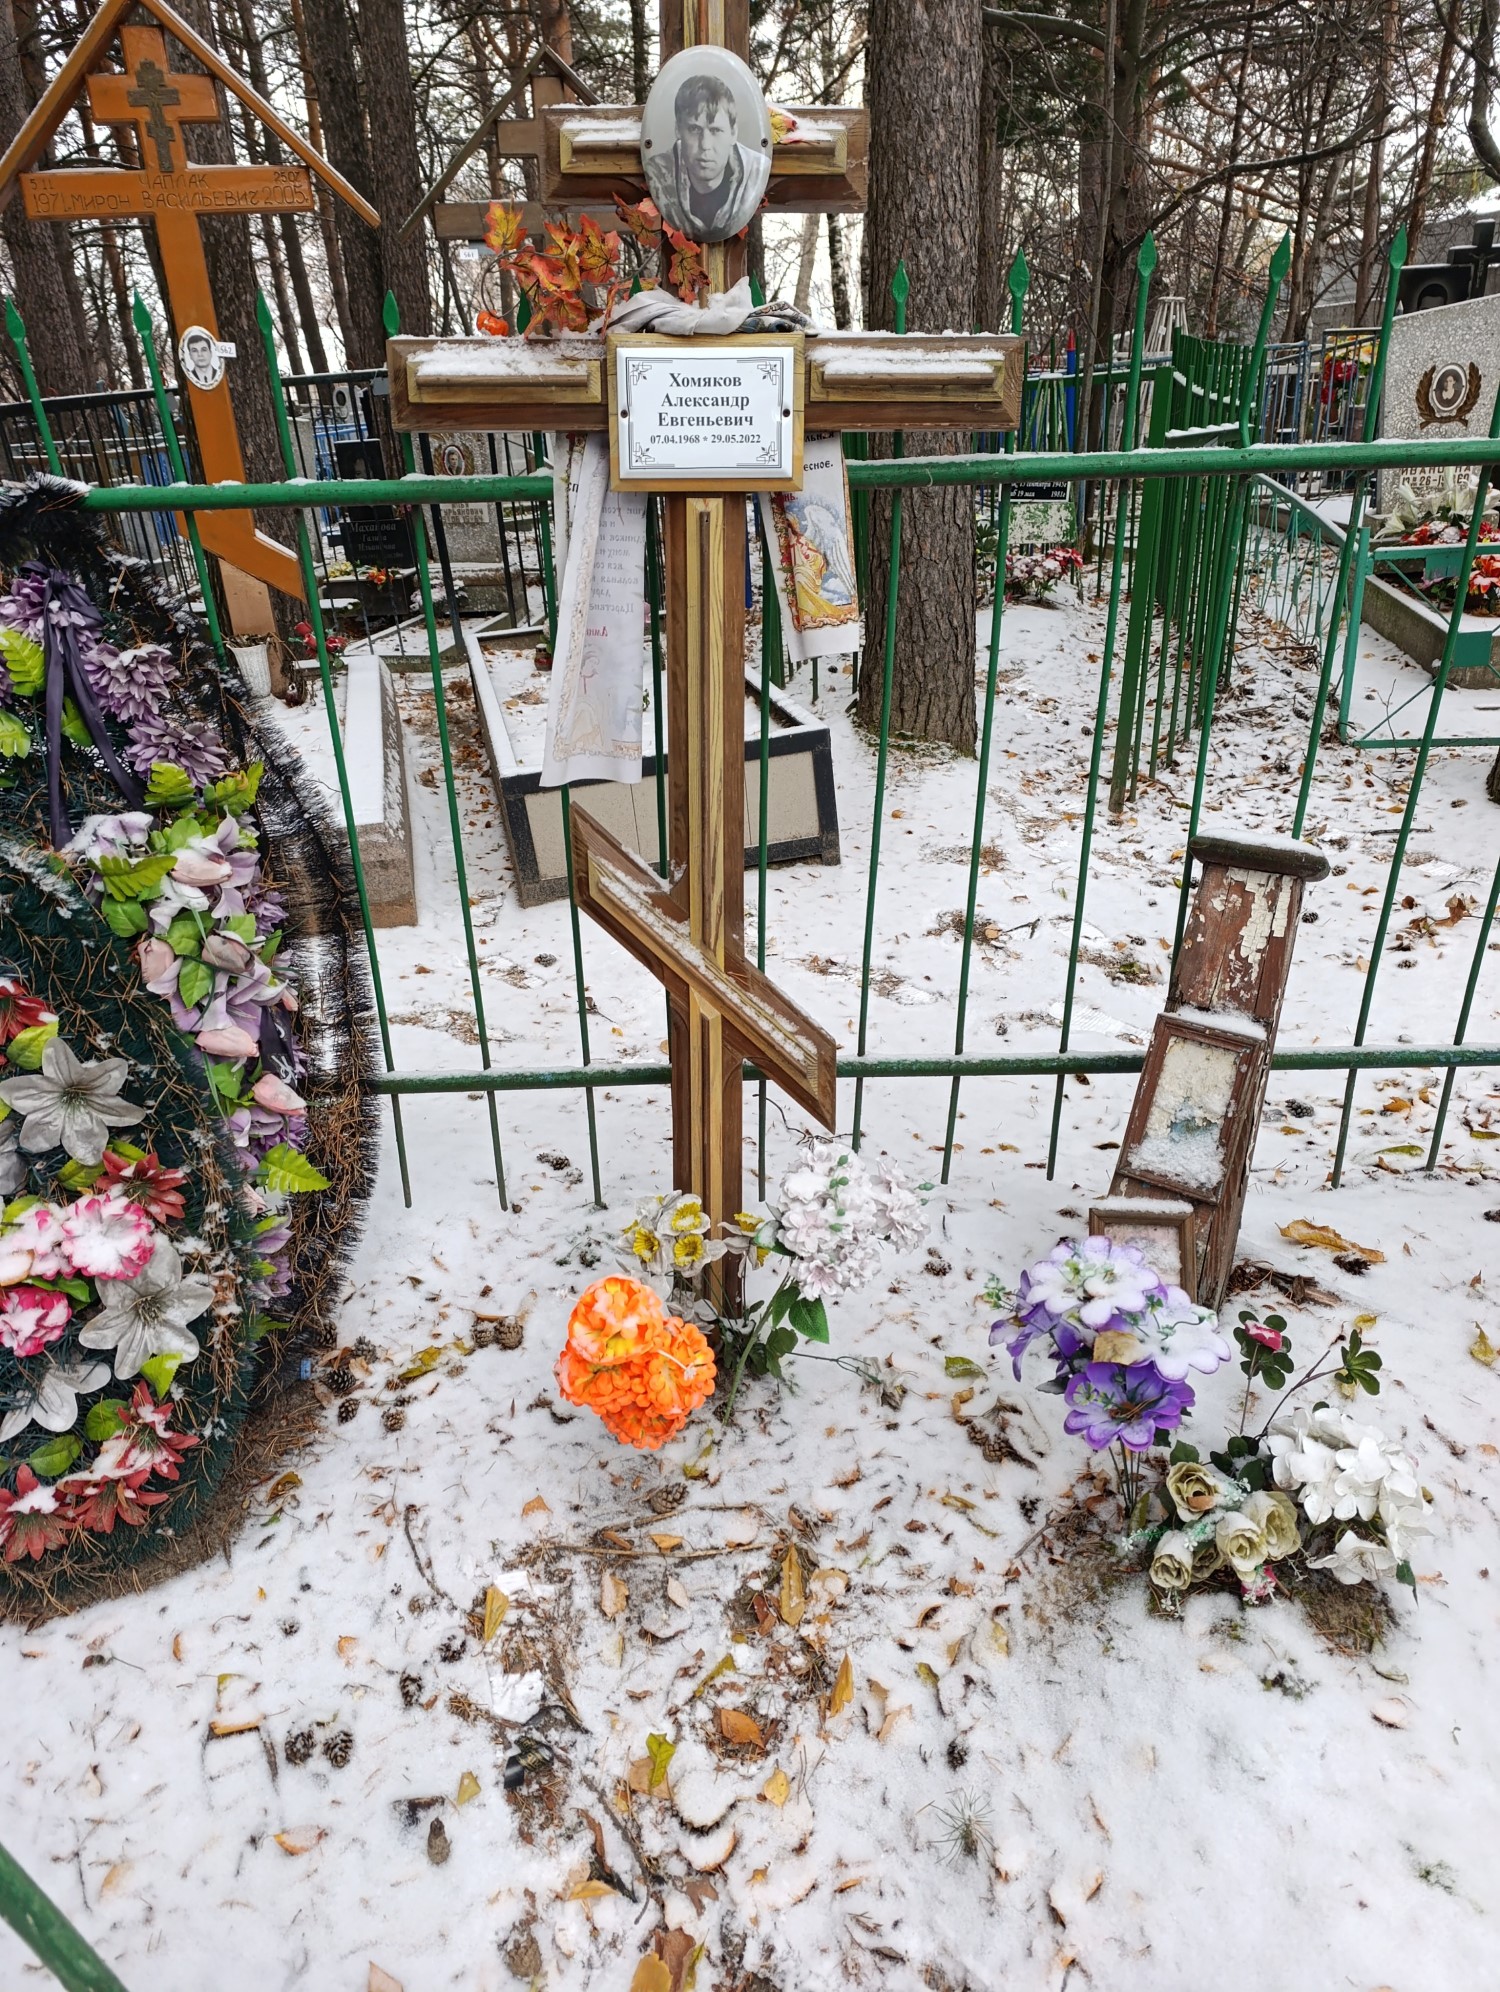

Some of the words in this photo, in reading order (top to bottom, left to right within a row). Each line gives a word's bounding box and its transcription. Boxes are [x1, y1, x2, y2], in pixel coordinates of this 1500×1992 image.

[138, 173, 209, 190] ЧАПЛАК
[141, 190, 259, 209] ВАСИЛЬЕВИЧ
[669, 373, 742, 388] Хомяков
[661, 393, 750, 410] Александр
[658, 412, 754, 427] Евгеньевич
[650, 434, 700, 444] 07.04.1968
[711, 434, 761, 444] 29.05.2022
[1401, 466, 1471, 476] ИВАНОНА
[442, 508, 484, 516] УРЬЯНОВИЧ
[351, 522, 396, 532] Махаова
[363, 534, 387, 542] Галиа
